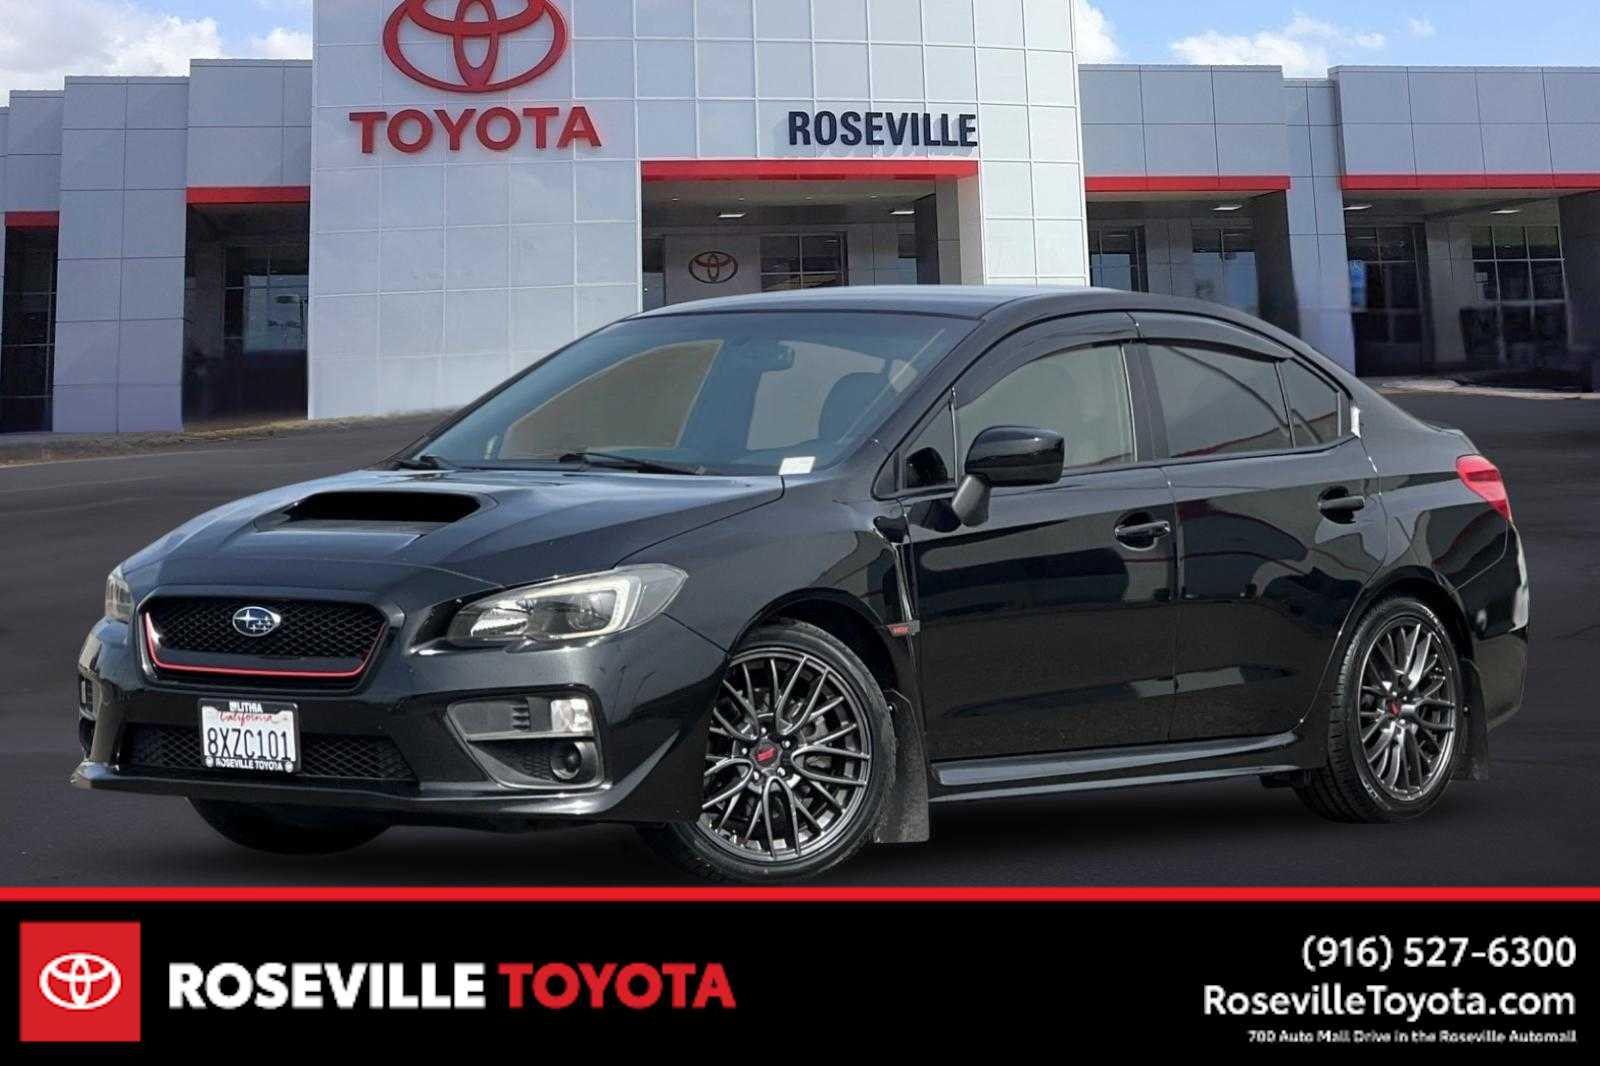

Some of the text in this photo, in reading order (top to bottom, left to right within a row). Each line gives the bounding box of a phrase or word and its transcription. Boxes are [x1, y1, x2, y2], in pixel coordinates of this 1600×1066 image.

[350, 106, 602, 154] TOYOTA
[788, 111, 979, 147] ROSEVILLE
[219, 712, 272, 726] California
[208, 728, 291, 760] 8XZC101
[215, 757, 283, 771] ROSEVILLE TOYOTA
